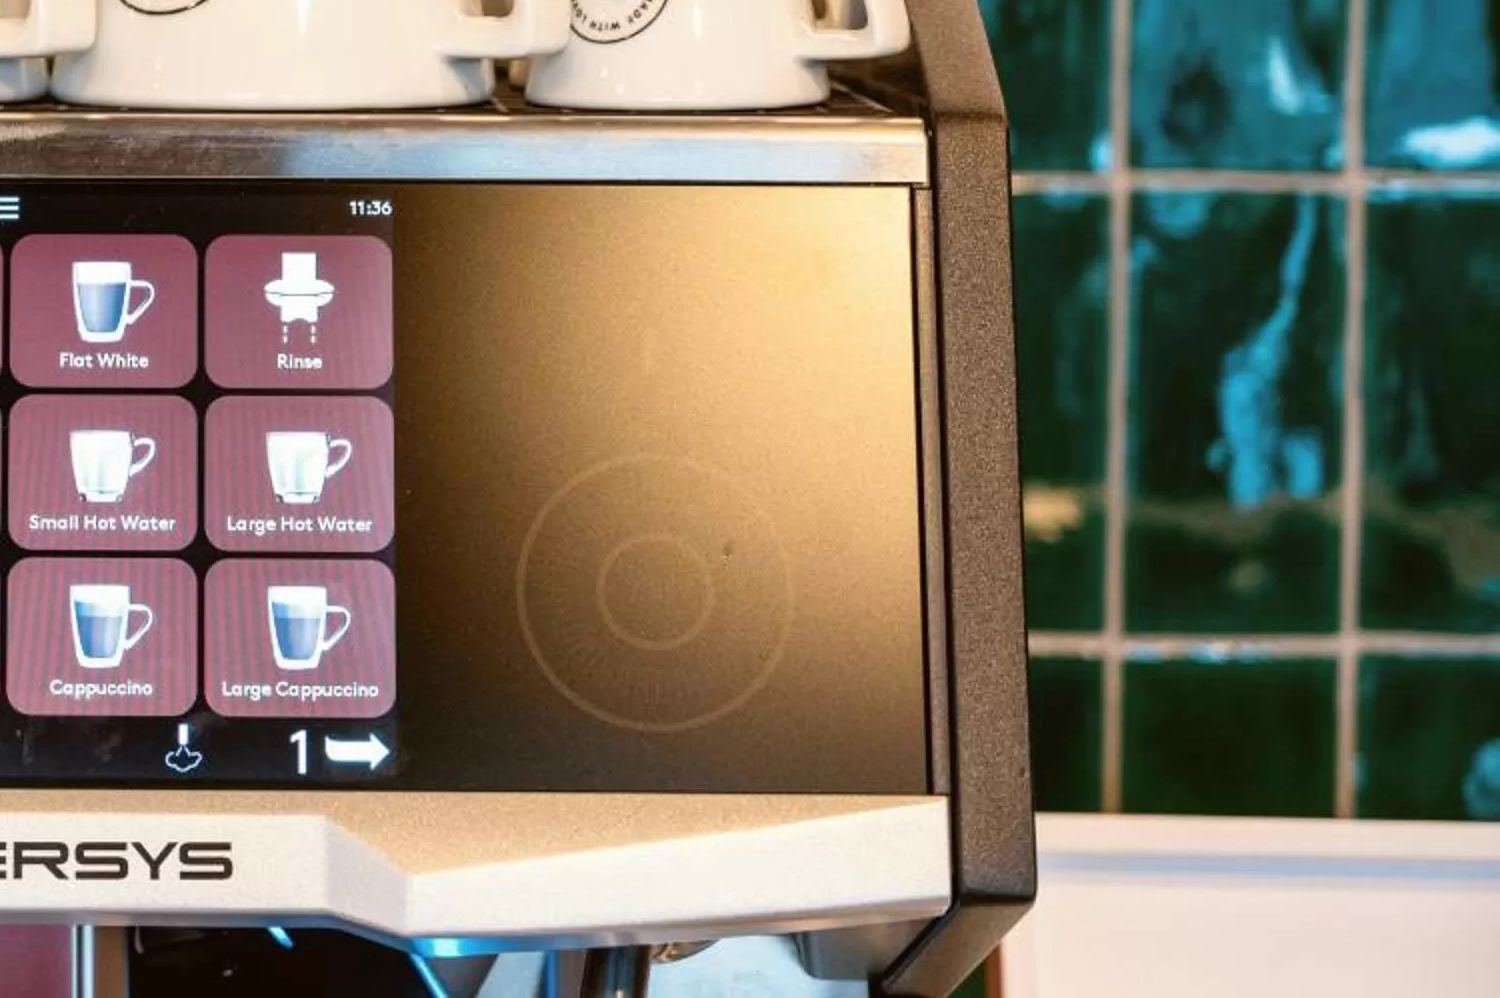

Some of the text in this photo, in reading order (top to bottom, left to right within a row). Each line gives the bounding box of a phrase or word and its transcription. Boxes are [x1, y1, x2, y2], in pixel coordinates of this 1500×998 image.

[349, 200, 393, 216] 11:36
[59, 352, 150, 369] Flat White
[276, 353, 323, 370] Rinse
[28, 515, 177, 532] Small Hot Water
[226, 516, 373, 536] Large Hot Water
[49, 679, 154, 700] Cappuccino
[221, 681, 380, 701] Large Cappuccino
[288, 729, 309, 775] 1
